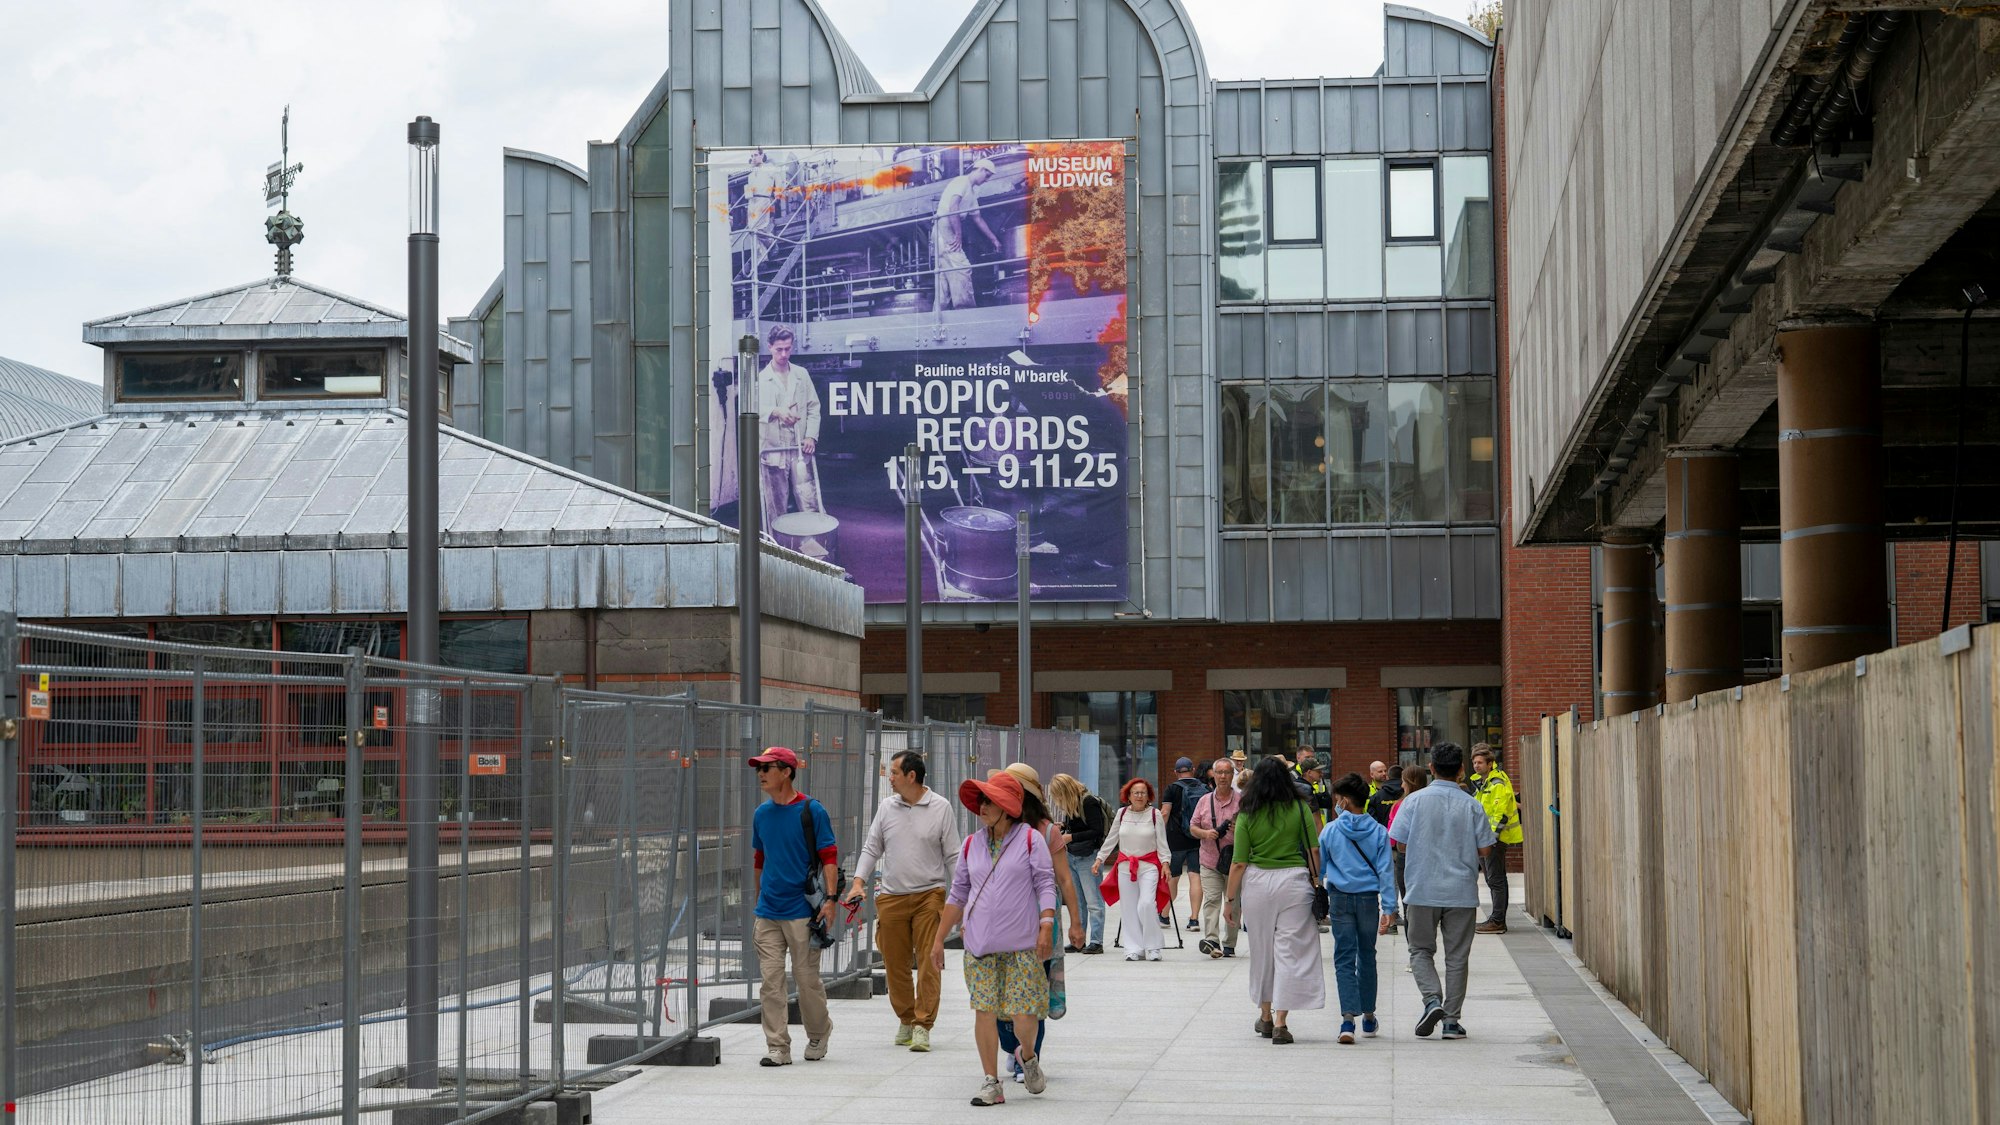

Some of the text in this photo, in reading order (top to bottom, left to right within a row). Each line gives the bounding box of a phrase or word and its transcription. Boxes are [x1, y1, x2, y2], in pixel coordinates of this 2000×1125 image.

[1028, 156, 1112, 172] MUSEUM
[1039, 172, 1112, 188] LUDWIG
[914, 363, 1068, 383] Pauline Hafsia M'barek
[828, 379, 1010, 416] ENTROPIC
[916, 415, 1090, 451] RECORDS
[997, 452, 1119, 489] 9.11.25
